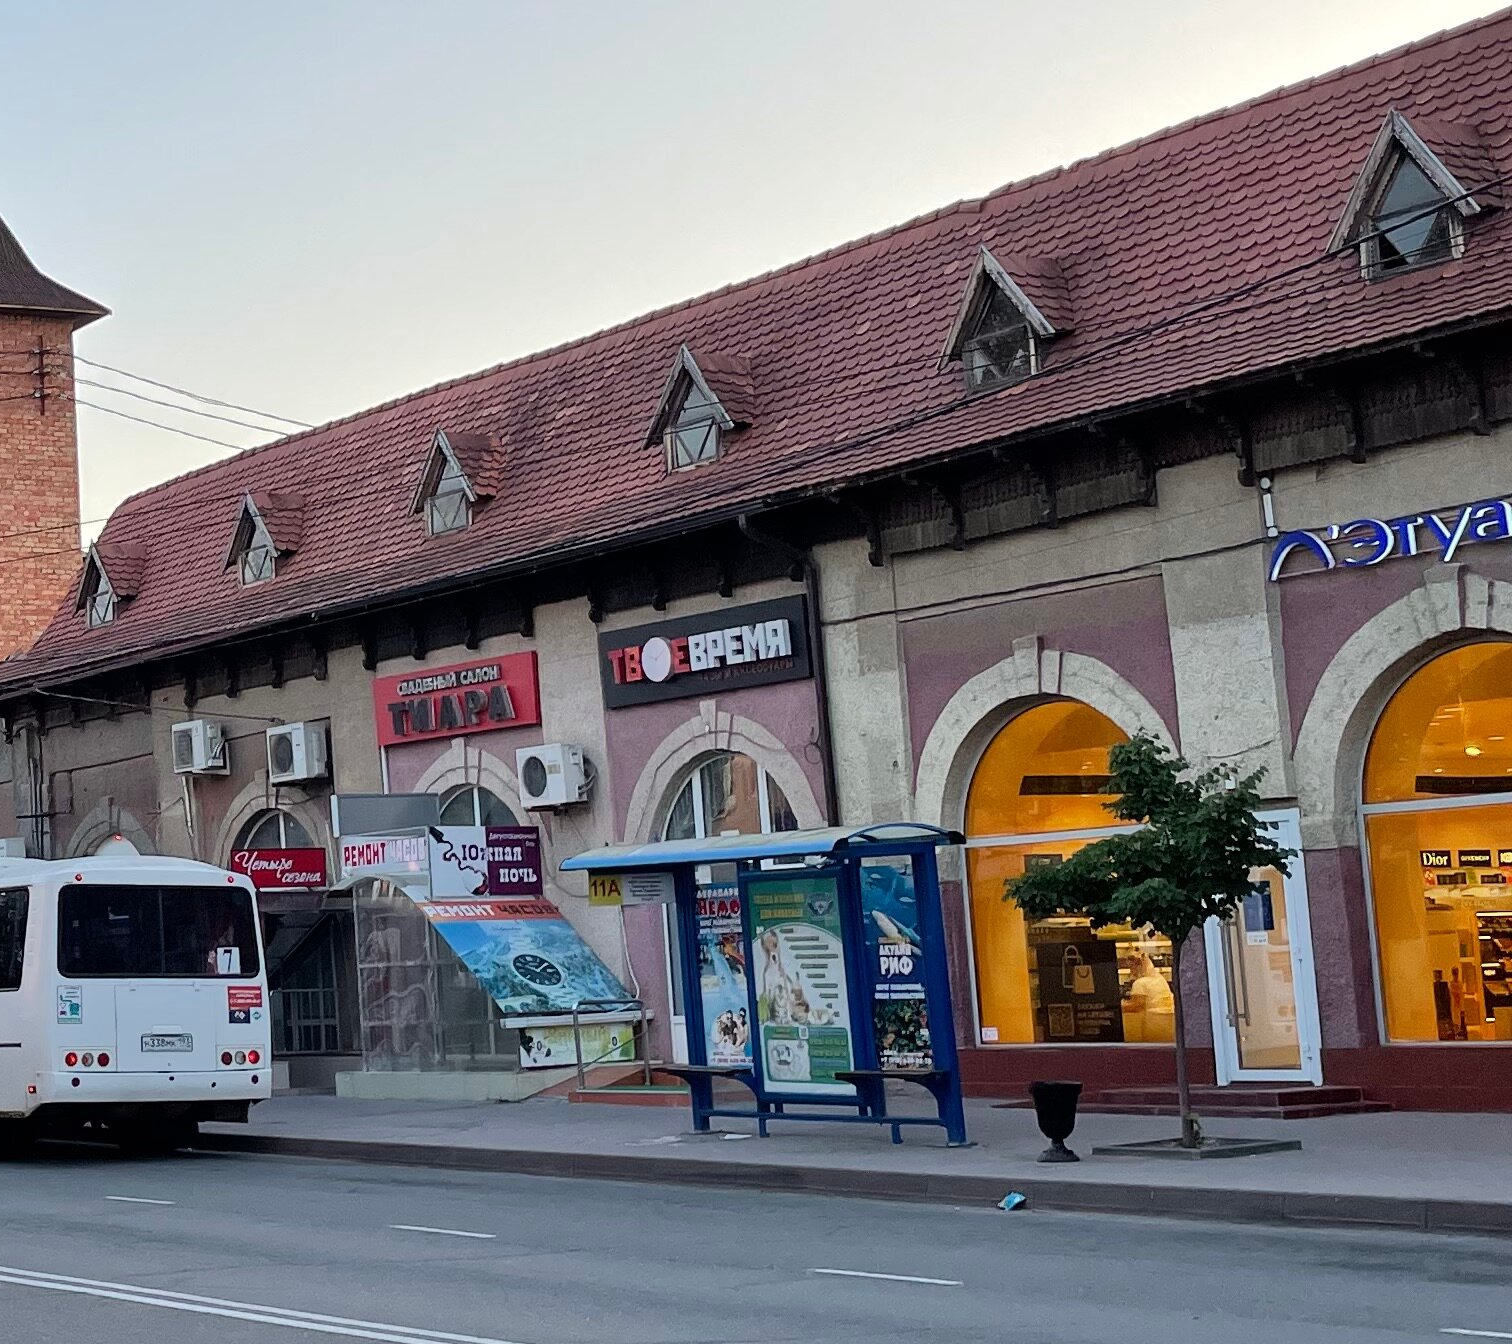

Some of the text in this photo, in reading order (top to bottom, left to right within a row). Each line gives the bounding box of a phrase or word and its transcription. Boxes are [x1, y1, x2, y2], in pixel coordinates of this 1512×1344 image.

[688, 619, 792, 671] ВРЕМЯ
[397, 665, 501, 696] СВАДЕБНЫЙ САЛОН
[388, 684, 515, 736] ТИАРА
[344, 837, 427, 867] РЕМОНТ ЧАСОВ
[1422, 852, 1448, 866] Dior
[282, 872, 321, 883] сезона
[423, 904, 559, 918] РЕМОНТ ЧАСОВ
[223, 949, 232, 972] 7
[880, 956, 913, 979] РИФ
